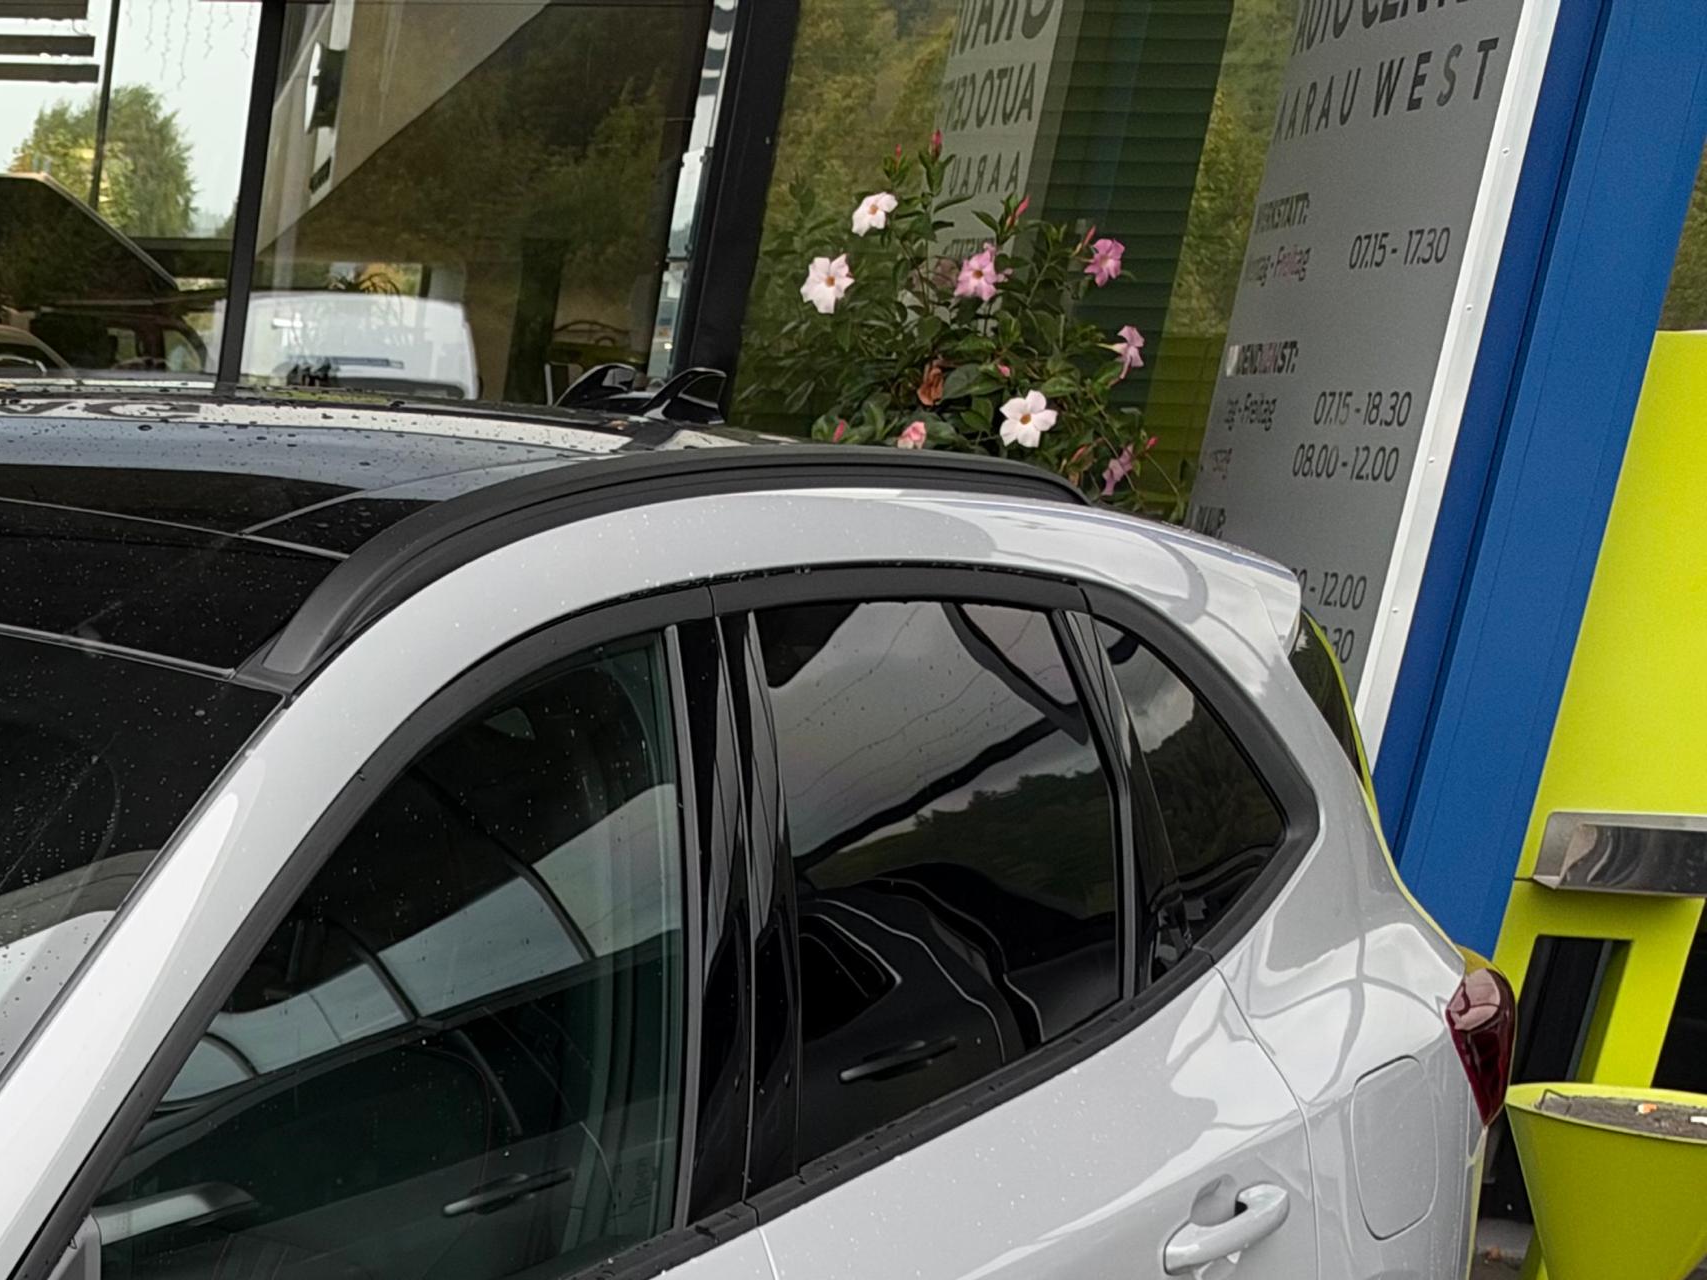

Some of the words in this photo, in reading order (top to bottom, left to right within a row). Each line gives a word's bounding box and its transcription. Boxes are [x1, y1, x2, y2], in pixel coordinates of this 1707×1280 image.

[1373, 37, 1499, 119] WEST
[1348, 232, 1389, 269] 07.15
[1403, 226, 1450, 266] 17.30
[1313, 391, 1353, 426] 07.15
[1363, 391, 1413, 428] 18.30
[1292, 443, 1338, 478] 08.00
[1350, 446, 1399, 482] 12.00
[1318, 571, 1368, 611] 12.00
